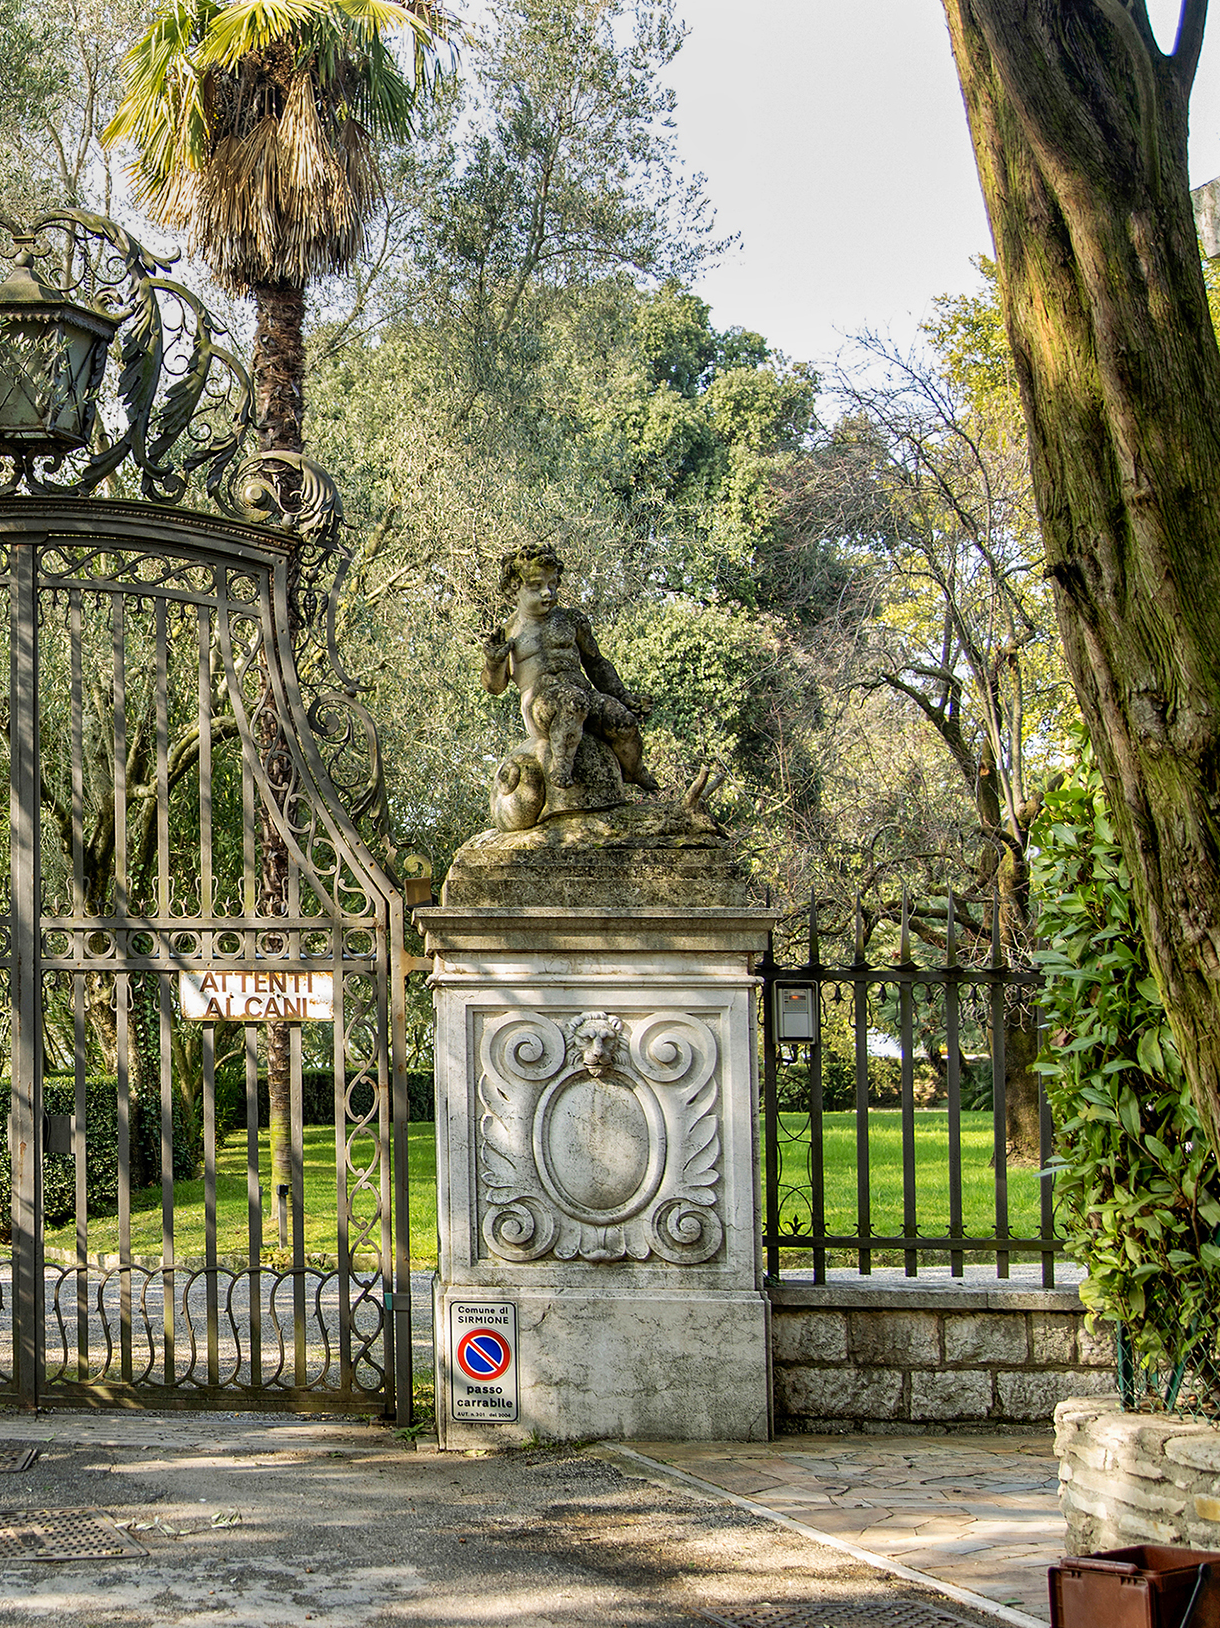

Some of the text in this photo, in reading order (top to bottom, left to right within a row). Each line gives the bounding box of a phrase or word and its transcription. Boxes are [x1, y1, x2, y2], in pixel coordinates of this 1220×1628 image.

[199, 971, 313, 993] ATTENTI
[205, 996, 308, 1018] AI CANI
[457, 1305, 508, 1314] Comune di
[457, 1315, 509, 1324] SIRMIONE
[466, 1386, 503, 1396] passo
[457, 1398, 513, 1408] carrabile
